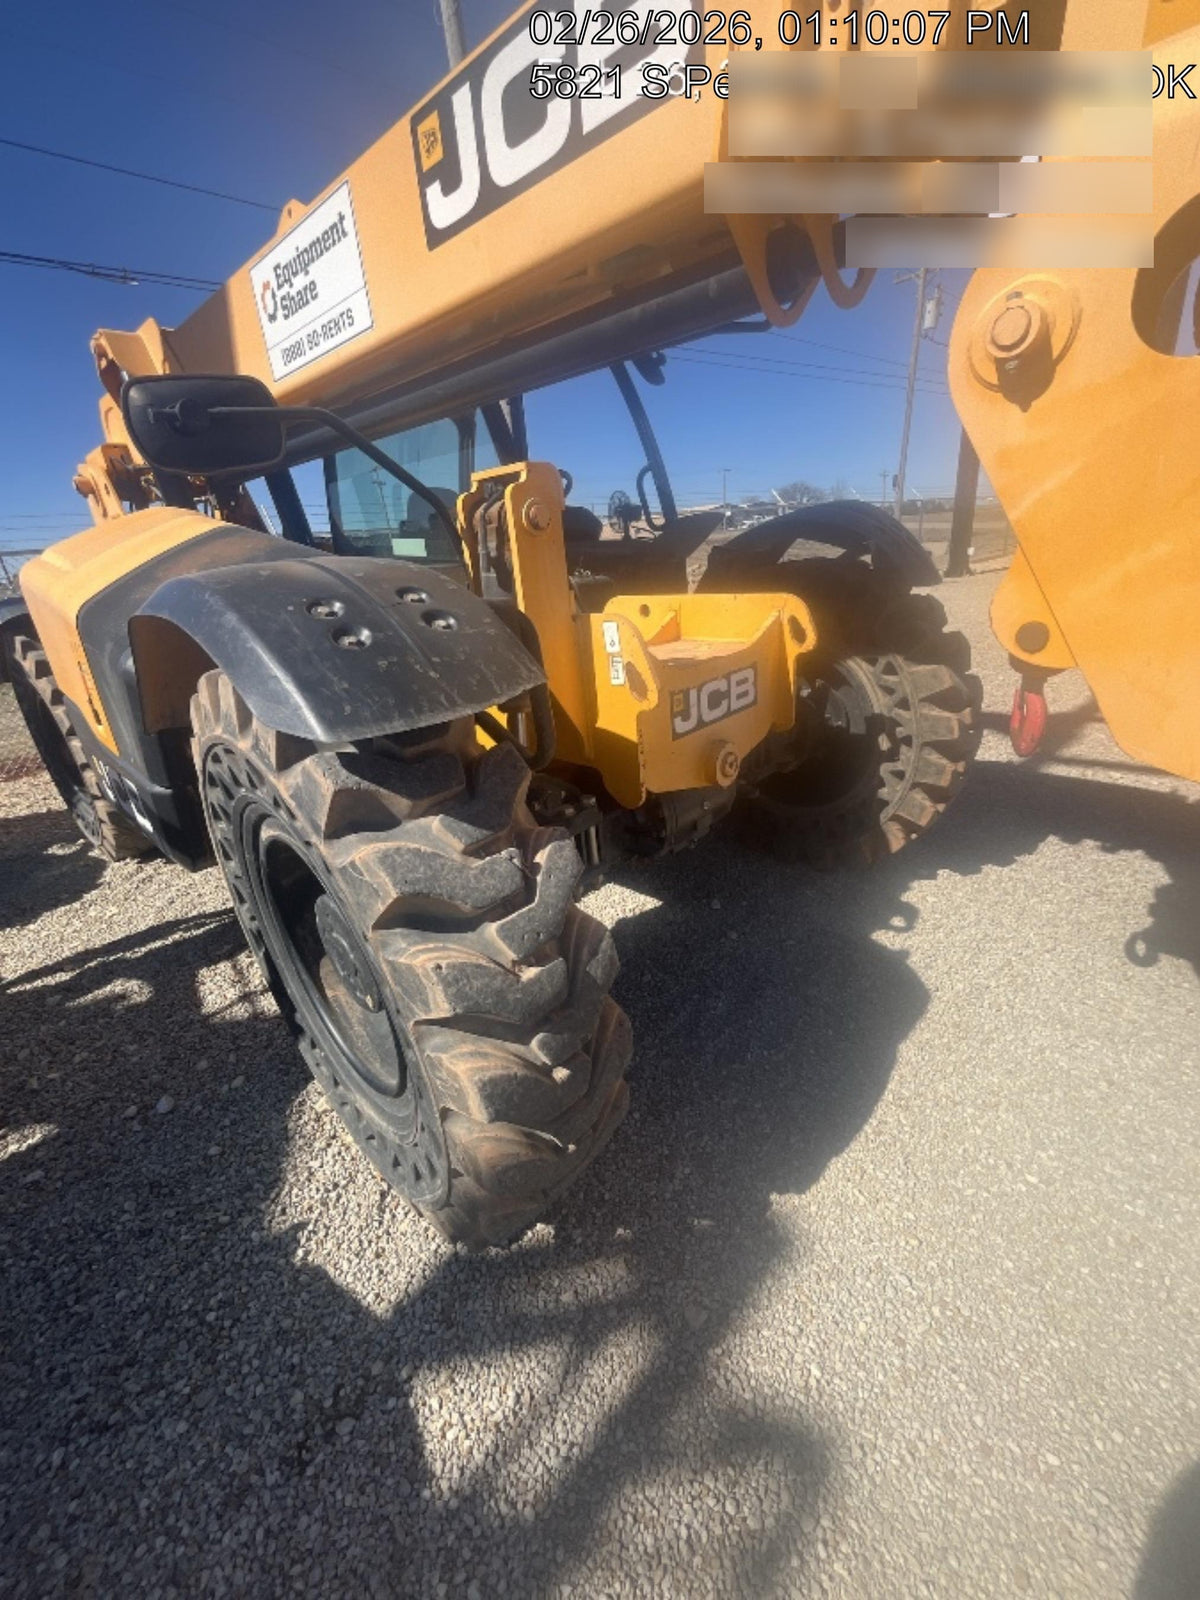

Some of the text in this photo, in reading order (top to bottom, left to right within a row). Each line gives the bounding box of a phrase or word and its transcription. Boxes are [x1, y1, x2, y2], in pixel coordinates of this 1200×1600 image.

[426, 0, 695, 229] JCB
[273, 211, 349, 290] Equipment
[279, 279, 319, 321] Share
[673, 667, 756, 734] JCB
